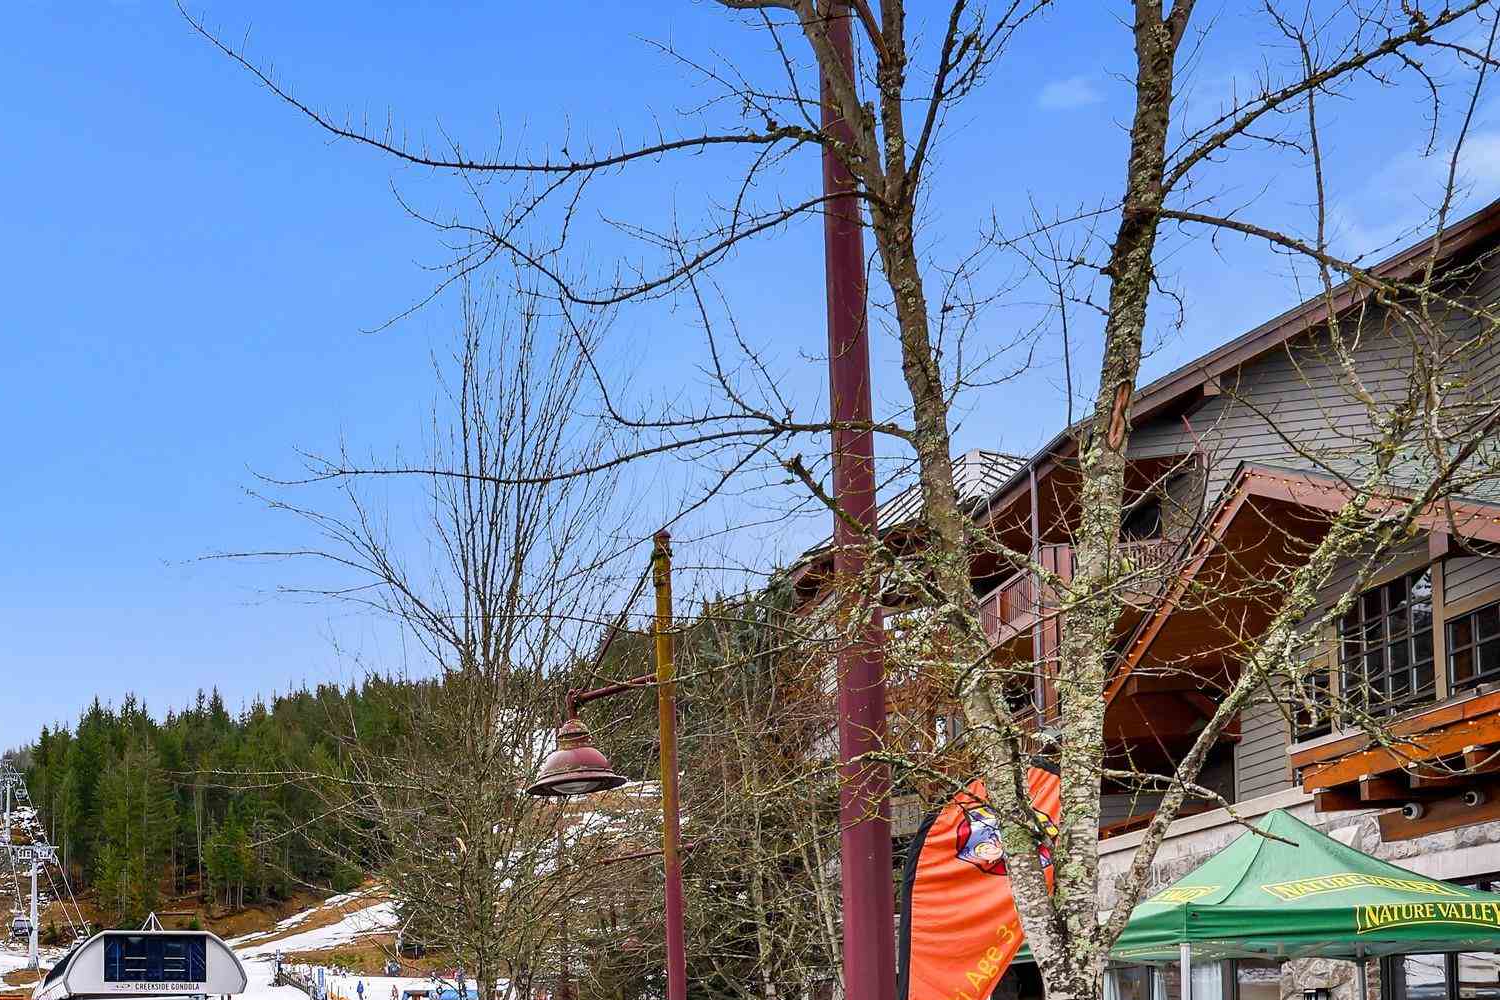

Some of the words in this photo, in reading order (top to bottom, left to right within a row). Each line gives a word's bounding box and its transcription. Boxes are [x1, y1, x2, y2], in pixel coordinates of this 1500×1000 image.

[1274, 874, 1363, 899] NATURE
[1365, 903, 1436, 928] NATURE
[965, 946, 1003, 992] Age
[135, 983, 170, 991] CREEKSIDE
[171, 983, 200, 991] GONDOLA
